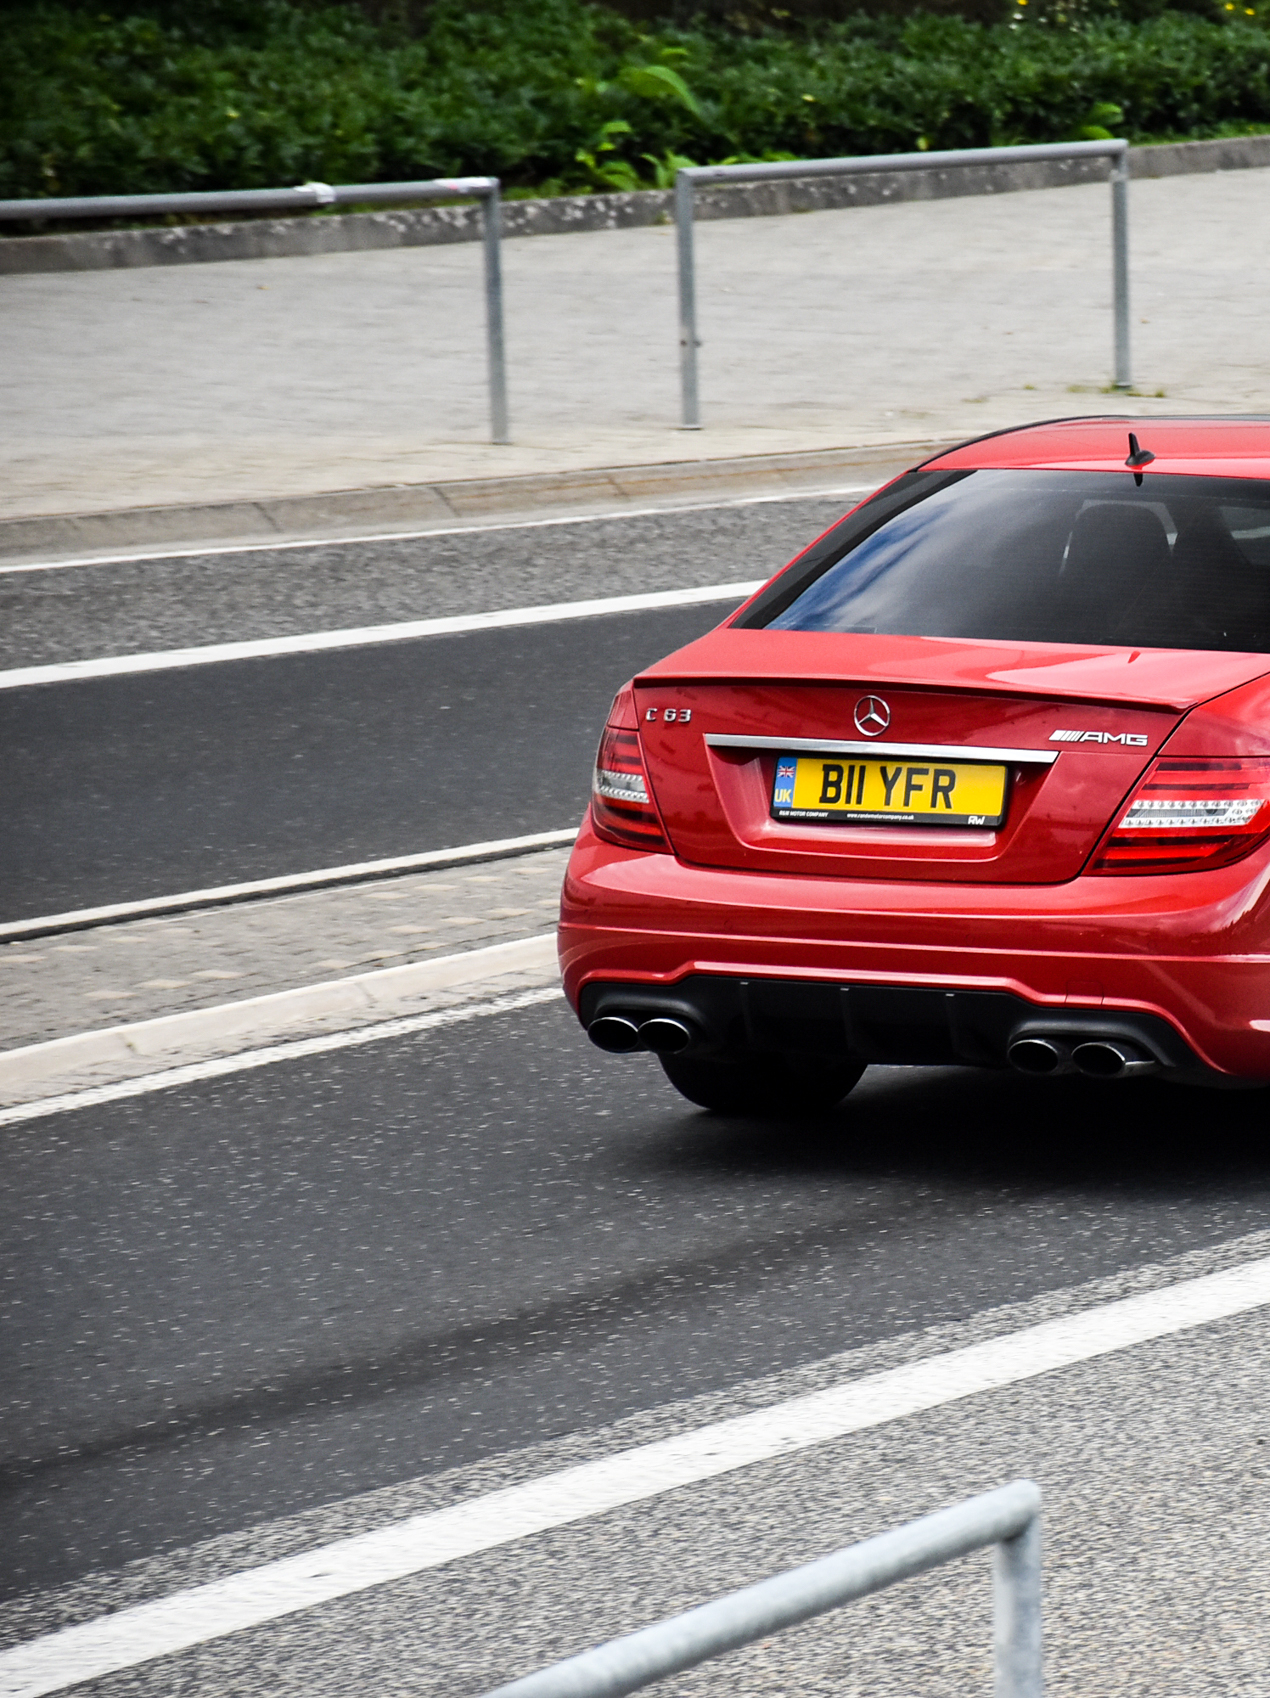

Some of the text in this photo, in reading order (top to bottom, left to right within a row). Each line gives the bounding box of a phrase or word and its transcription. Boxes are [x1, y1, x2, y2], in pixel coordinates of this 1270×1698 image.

[646, 707, 691, 722] C 63
[1080, 731, 1148, 746] AMG
[880, 765, 957, 809] YFR
[774, 788, 792, 803] UK
